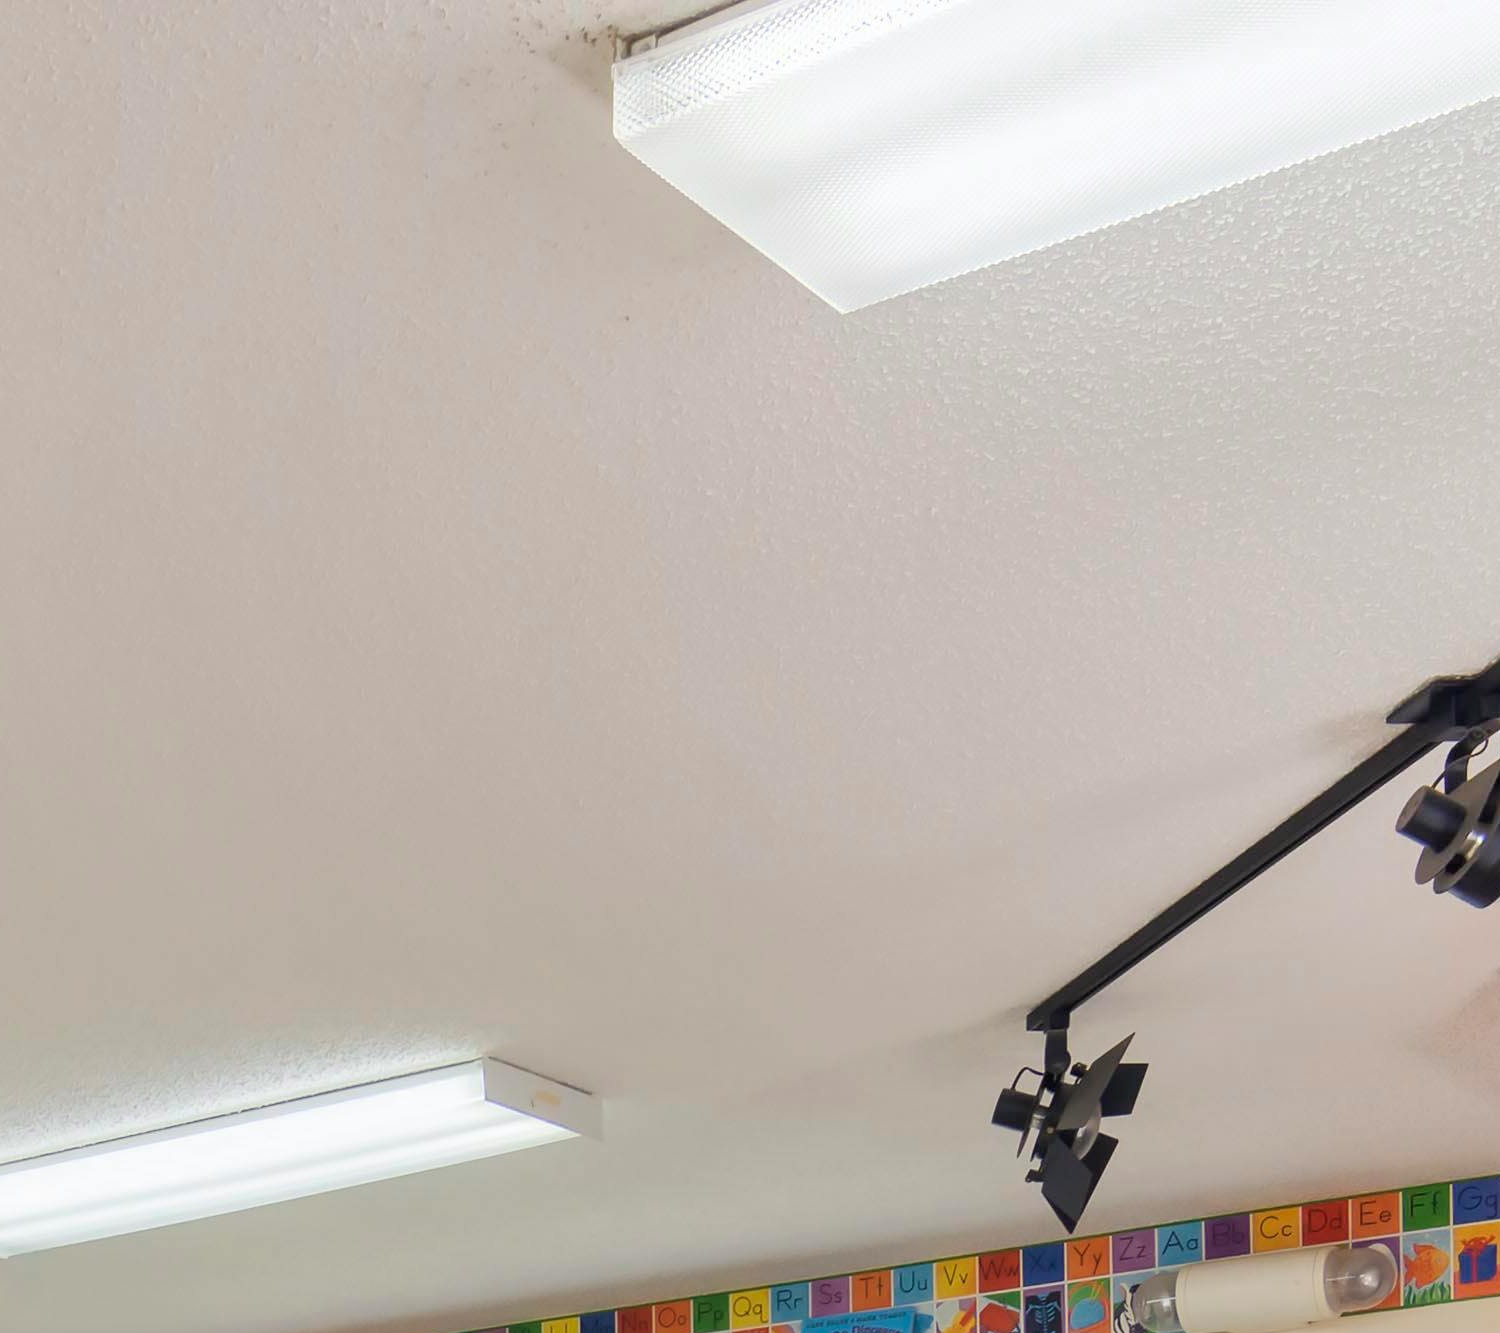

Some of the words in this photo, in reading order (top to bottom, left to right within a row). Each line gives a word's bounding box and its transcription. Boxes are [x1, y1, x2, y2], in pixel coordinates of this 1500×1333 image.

[900, 1271, 928, 1293] Uu
[1163, 1230, 1198, 1255] Aa
[1259, 1216, 1293, 1239] Cc
[1359, 1201, 1391, 1226] Ee
